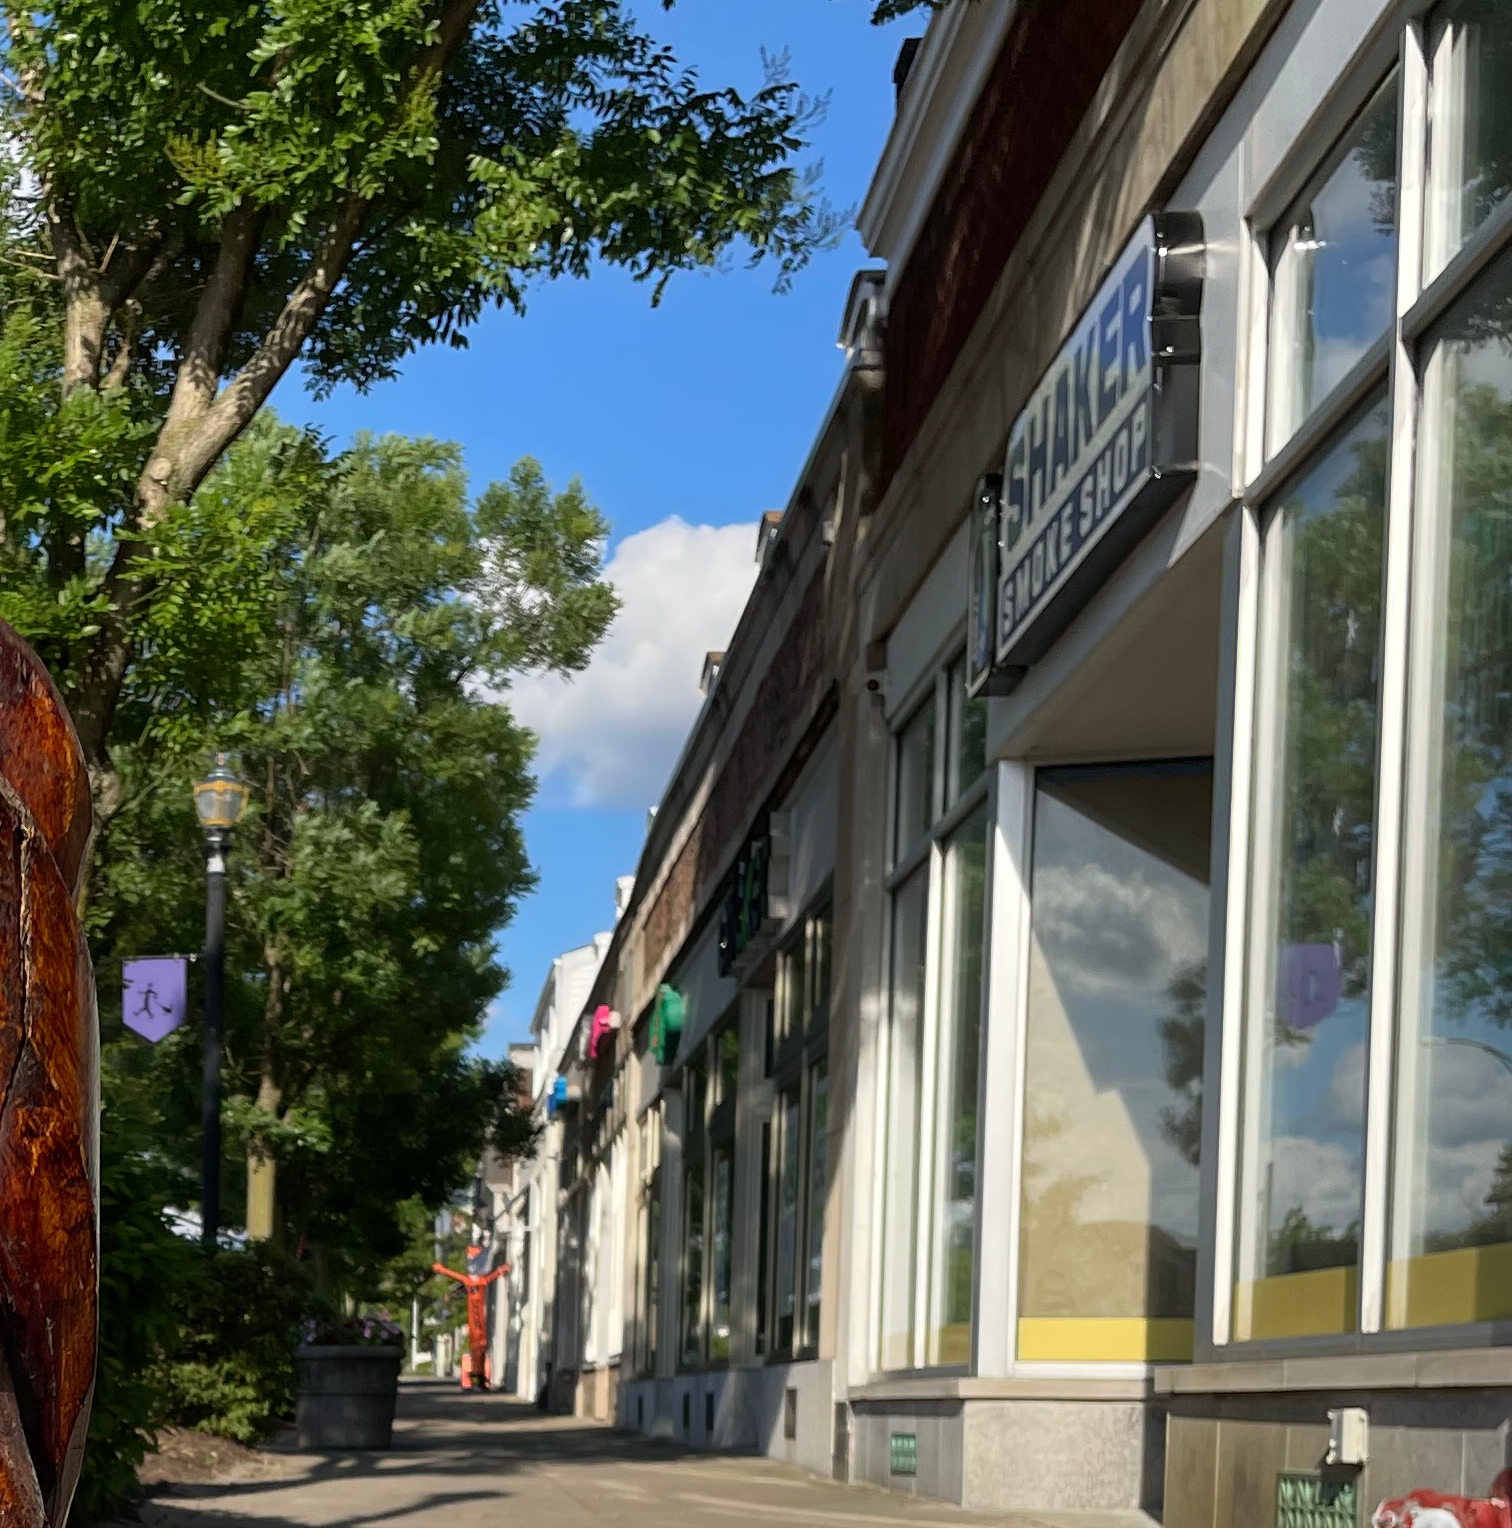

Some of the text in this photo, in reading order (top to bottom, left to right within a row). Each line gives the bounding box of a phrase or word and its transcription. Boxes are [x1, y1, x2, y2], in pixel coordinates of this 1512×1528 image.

[1002, 403, 1146, 638] SMOKE SHOP
[1007, 246, 1149, 553] SHAKER
